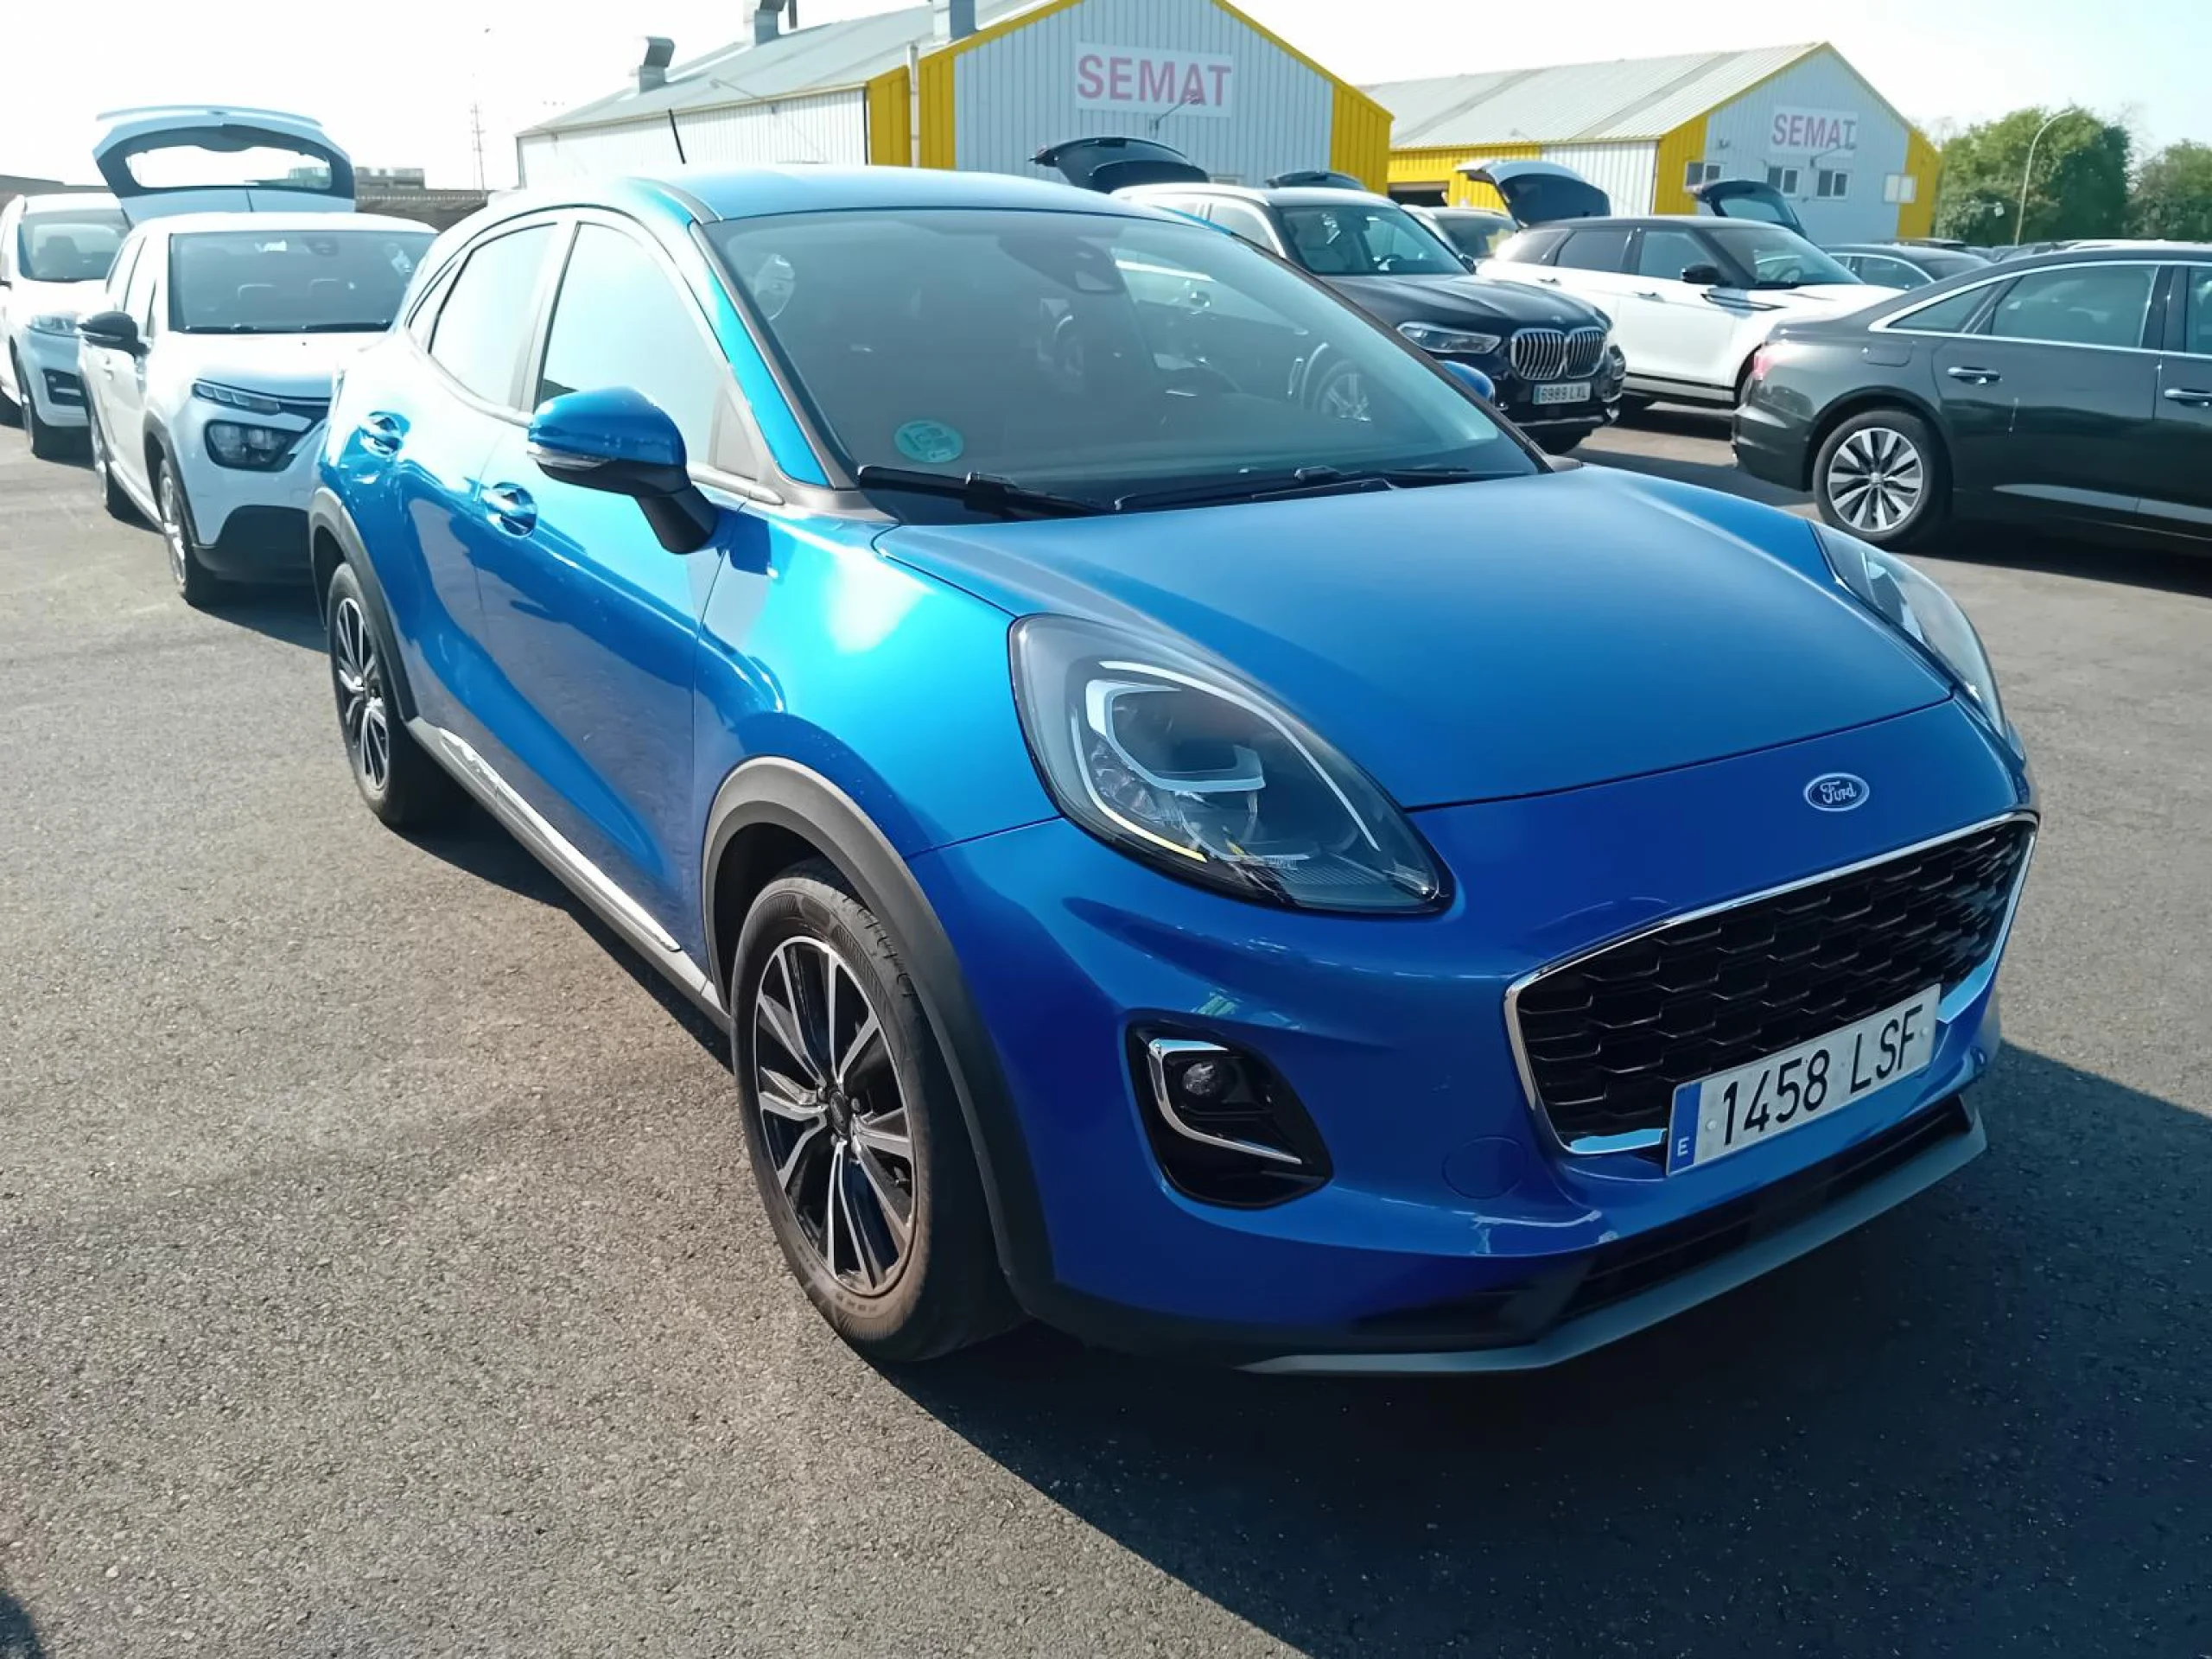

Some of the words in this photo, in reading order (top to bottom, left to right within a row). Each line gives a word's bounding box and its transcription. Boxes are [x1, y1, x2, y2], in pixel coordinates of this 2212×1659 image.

[1077, 54, 1232, 106] SEMAT
[1772, 112, 1856, 149] SEMAT
[1820, 780, 1857, 804] Ford
[1723, 1049, 1830, 1146] 1458
[1850, 1004, 1923, 1095] LSF
[1677, 1136, 1690, 1157] E
